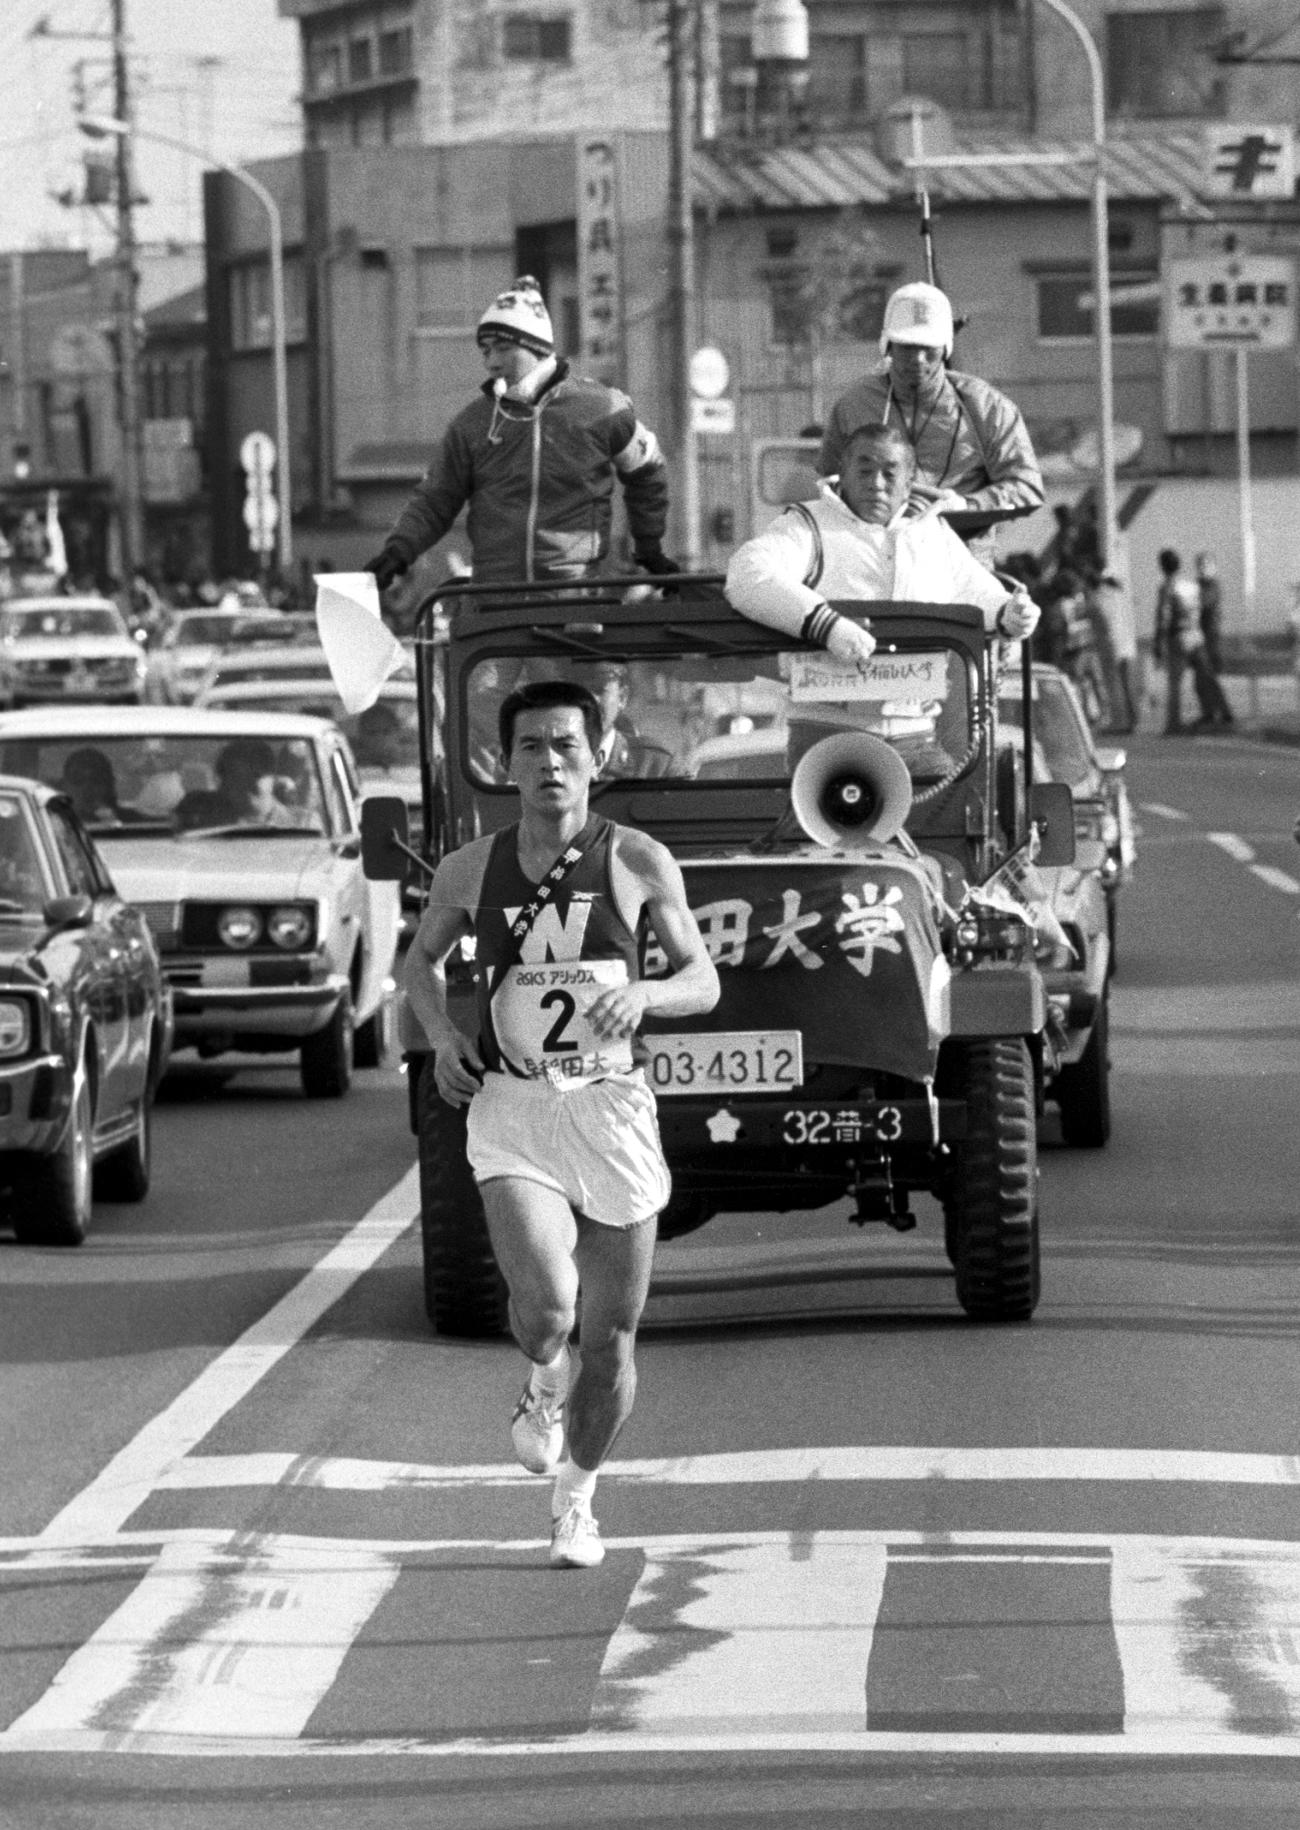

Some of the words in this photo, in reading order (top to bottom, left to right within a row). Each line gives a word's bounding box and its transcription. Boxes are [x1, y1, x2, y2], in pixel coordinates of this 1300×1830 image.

[513, 846, 583, 937] 早稲田大学
[645, 882, 905, 977] 田大学
[549, 969, 597, 985] アシックス
[540, 988, 578, 1053] 2
